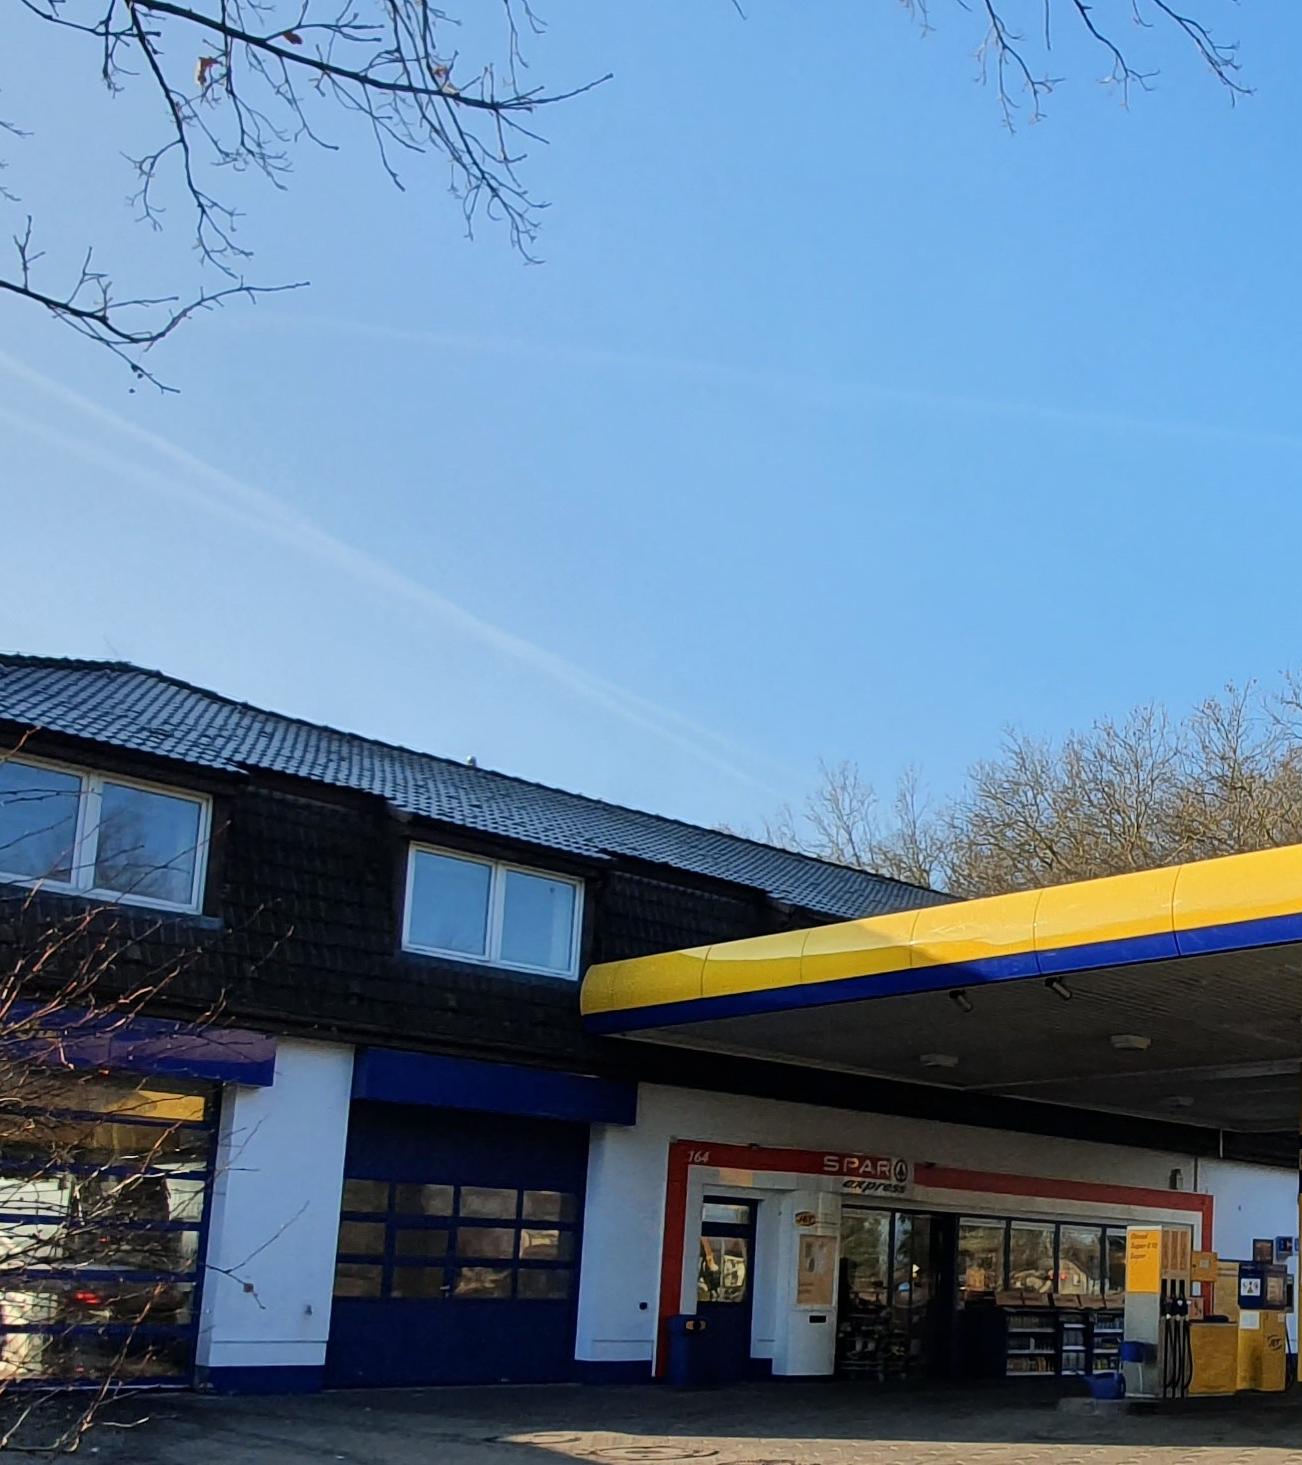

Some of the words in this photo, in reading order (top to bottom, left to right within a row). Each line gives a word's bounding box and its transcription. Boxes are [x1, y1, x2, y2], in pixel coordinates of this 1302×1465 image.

[687, 1151, 710, 1163] 164
[823, 1155, 891, 1177] SPAR
[842, 1180, 907, 1194] express
